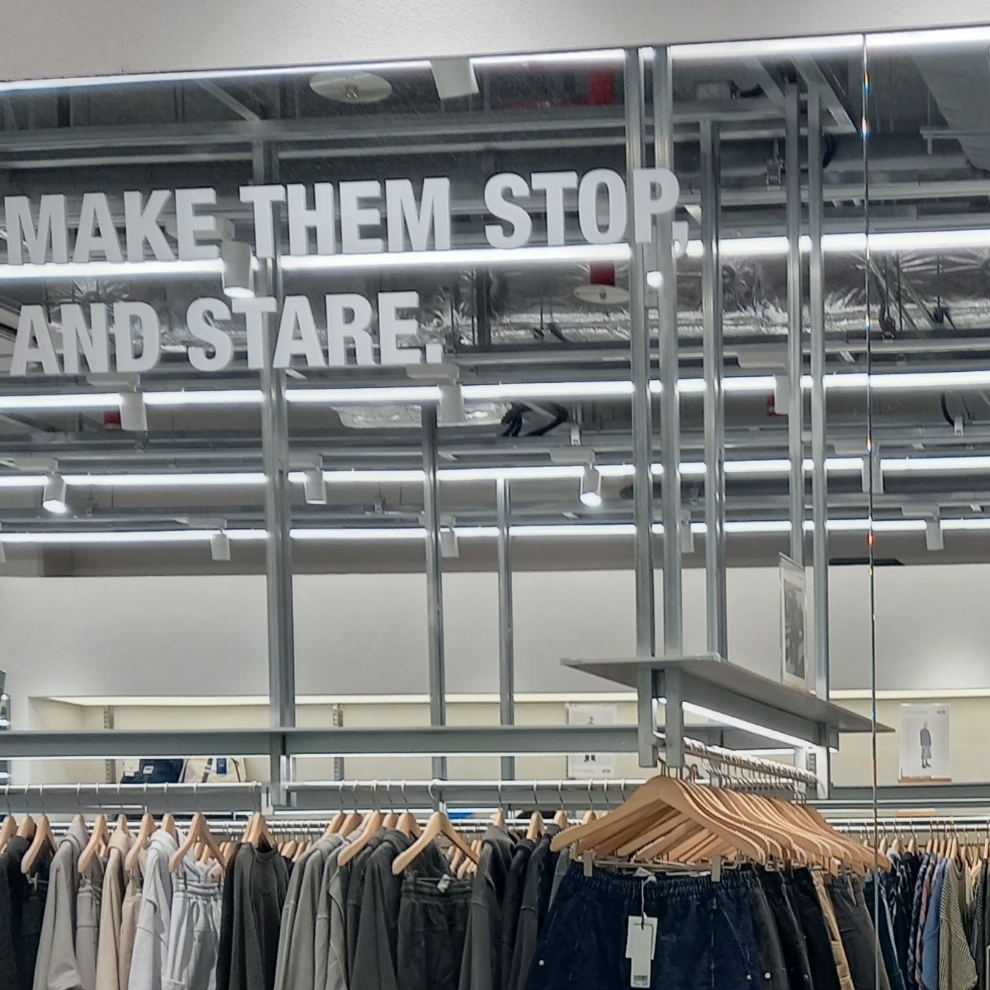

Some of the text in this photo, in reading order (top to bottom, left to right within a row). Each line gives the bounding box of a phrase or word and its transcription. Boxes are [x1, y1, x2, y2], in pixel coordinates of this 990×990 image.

[4, 168, 689, 266] MAKE THEM STOP,
[10, 291, 443, 377] AND STARE.
